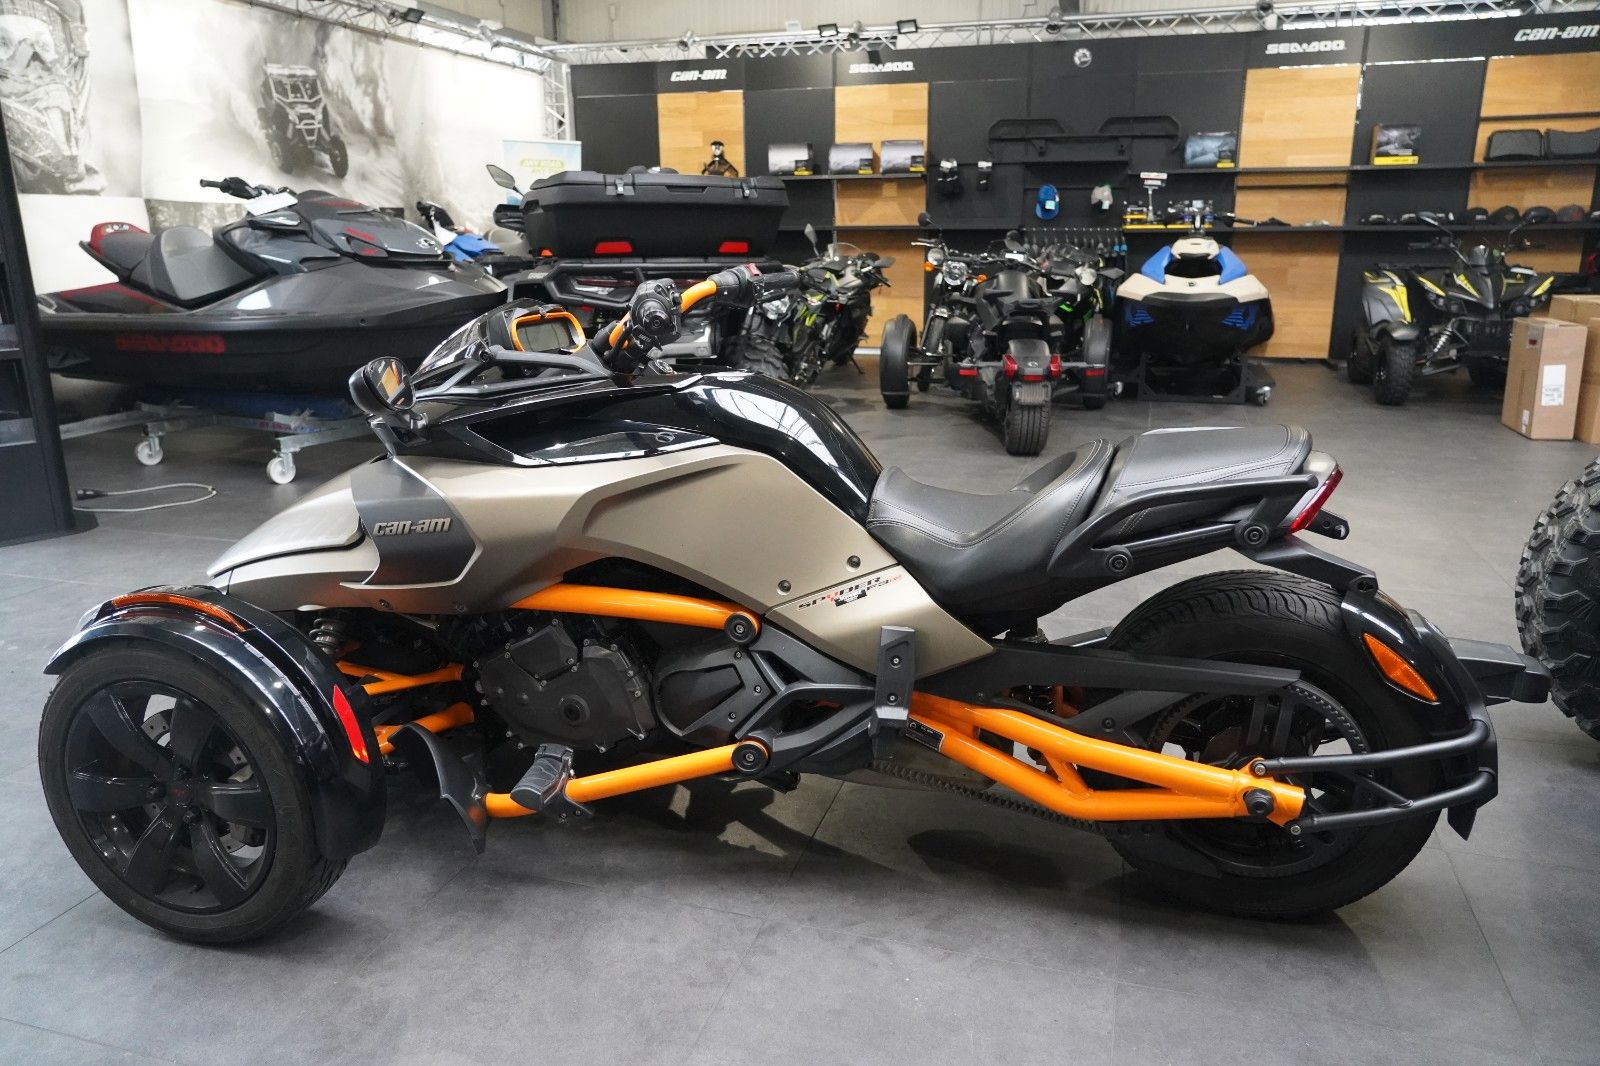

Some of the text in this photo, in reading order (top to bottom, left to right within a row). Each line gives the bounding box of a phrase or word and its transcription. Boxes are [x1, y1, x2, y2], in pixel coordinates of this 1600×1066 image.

[1514, 24, 1600, 41] can-am
[670, 69, 727, 81] can-am
[372, 518, 451, 536] can-am
